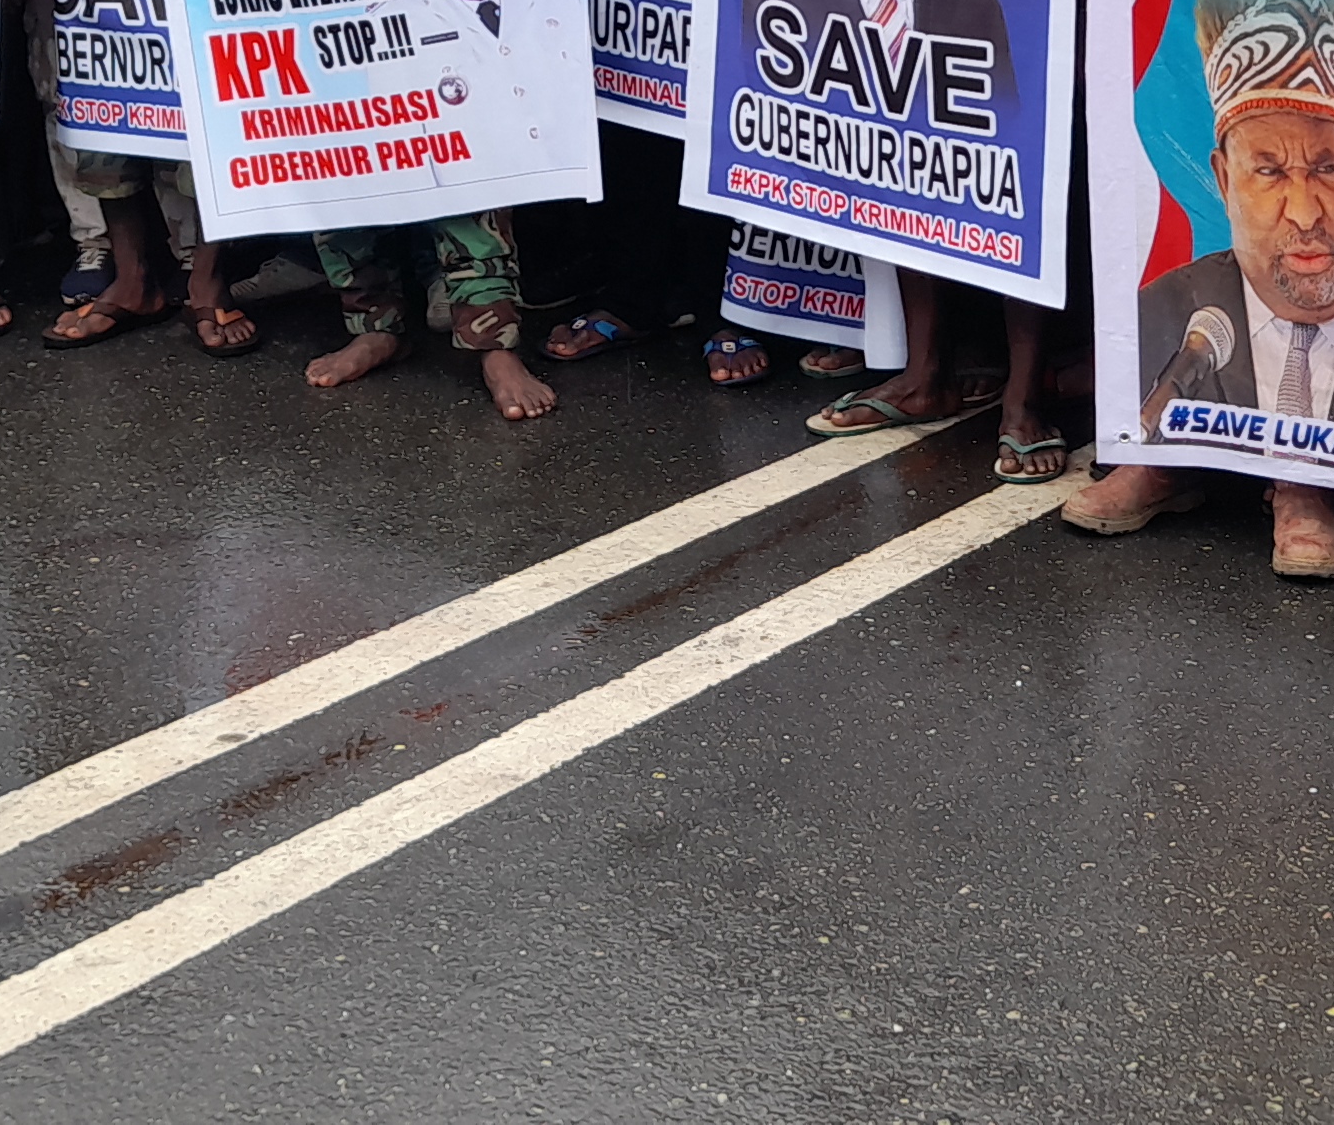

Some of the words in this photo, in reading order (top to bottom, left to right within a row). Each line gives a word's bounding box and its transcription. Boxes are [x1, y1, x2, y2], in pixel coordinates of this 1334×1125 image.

[56, 30, 169, 86] BERNUR
[209, 28, 309, 101] KPK
[759, 3, 992, 131] SAVE
[74, 99, 123, 123] STOP
[242, 89, 439, 140] KRIMINALISASI
[594, 67, 687, 108] KRIMINAL
[229, 143, 369, 188] GUBERNUR
[377, 131, 471, 171] PAPUA
[736, 95, 898, 181] GUBERNUR
[909, 138, 1019, 214] PAPUA
[730, 168, 785, 204] #KPK
[791, 182, 846, 216] STOP
[853, 198, 1021, 262] KRIMINALISASI
[733, 275, 797, 306] STOP
[1169, 404, 1264, 446] #SAVE
